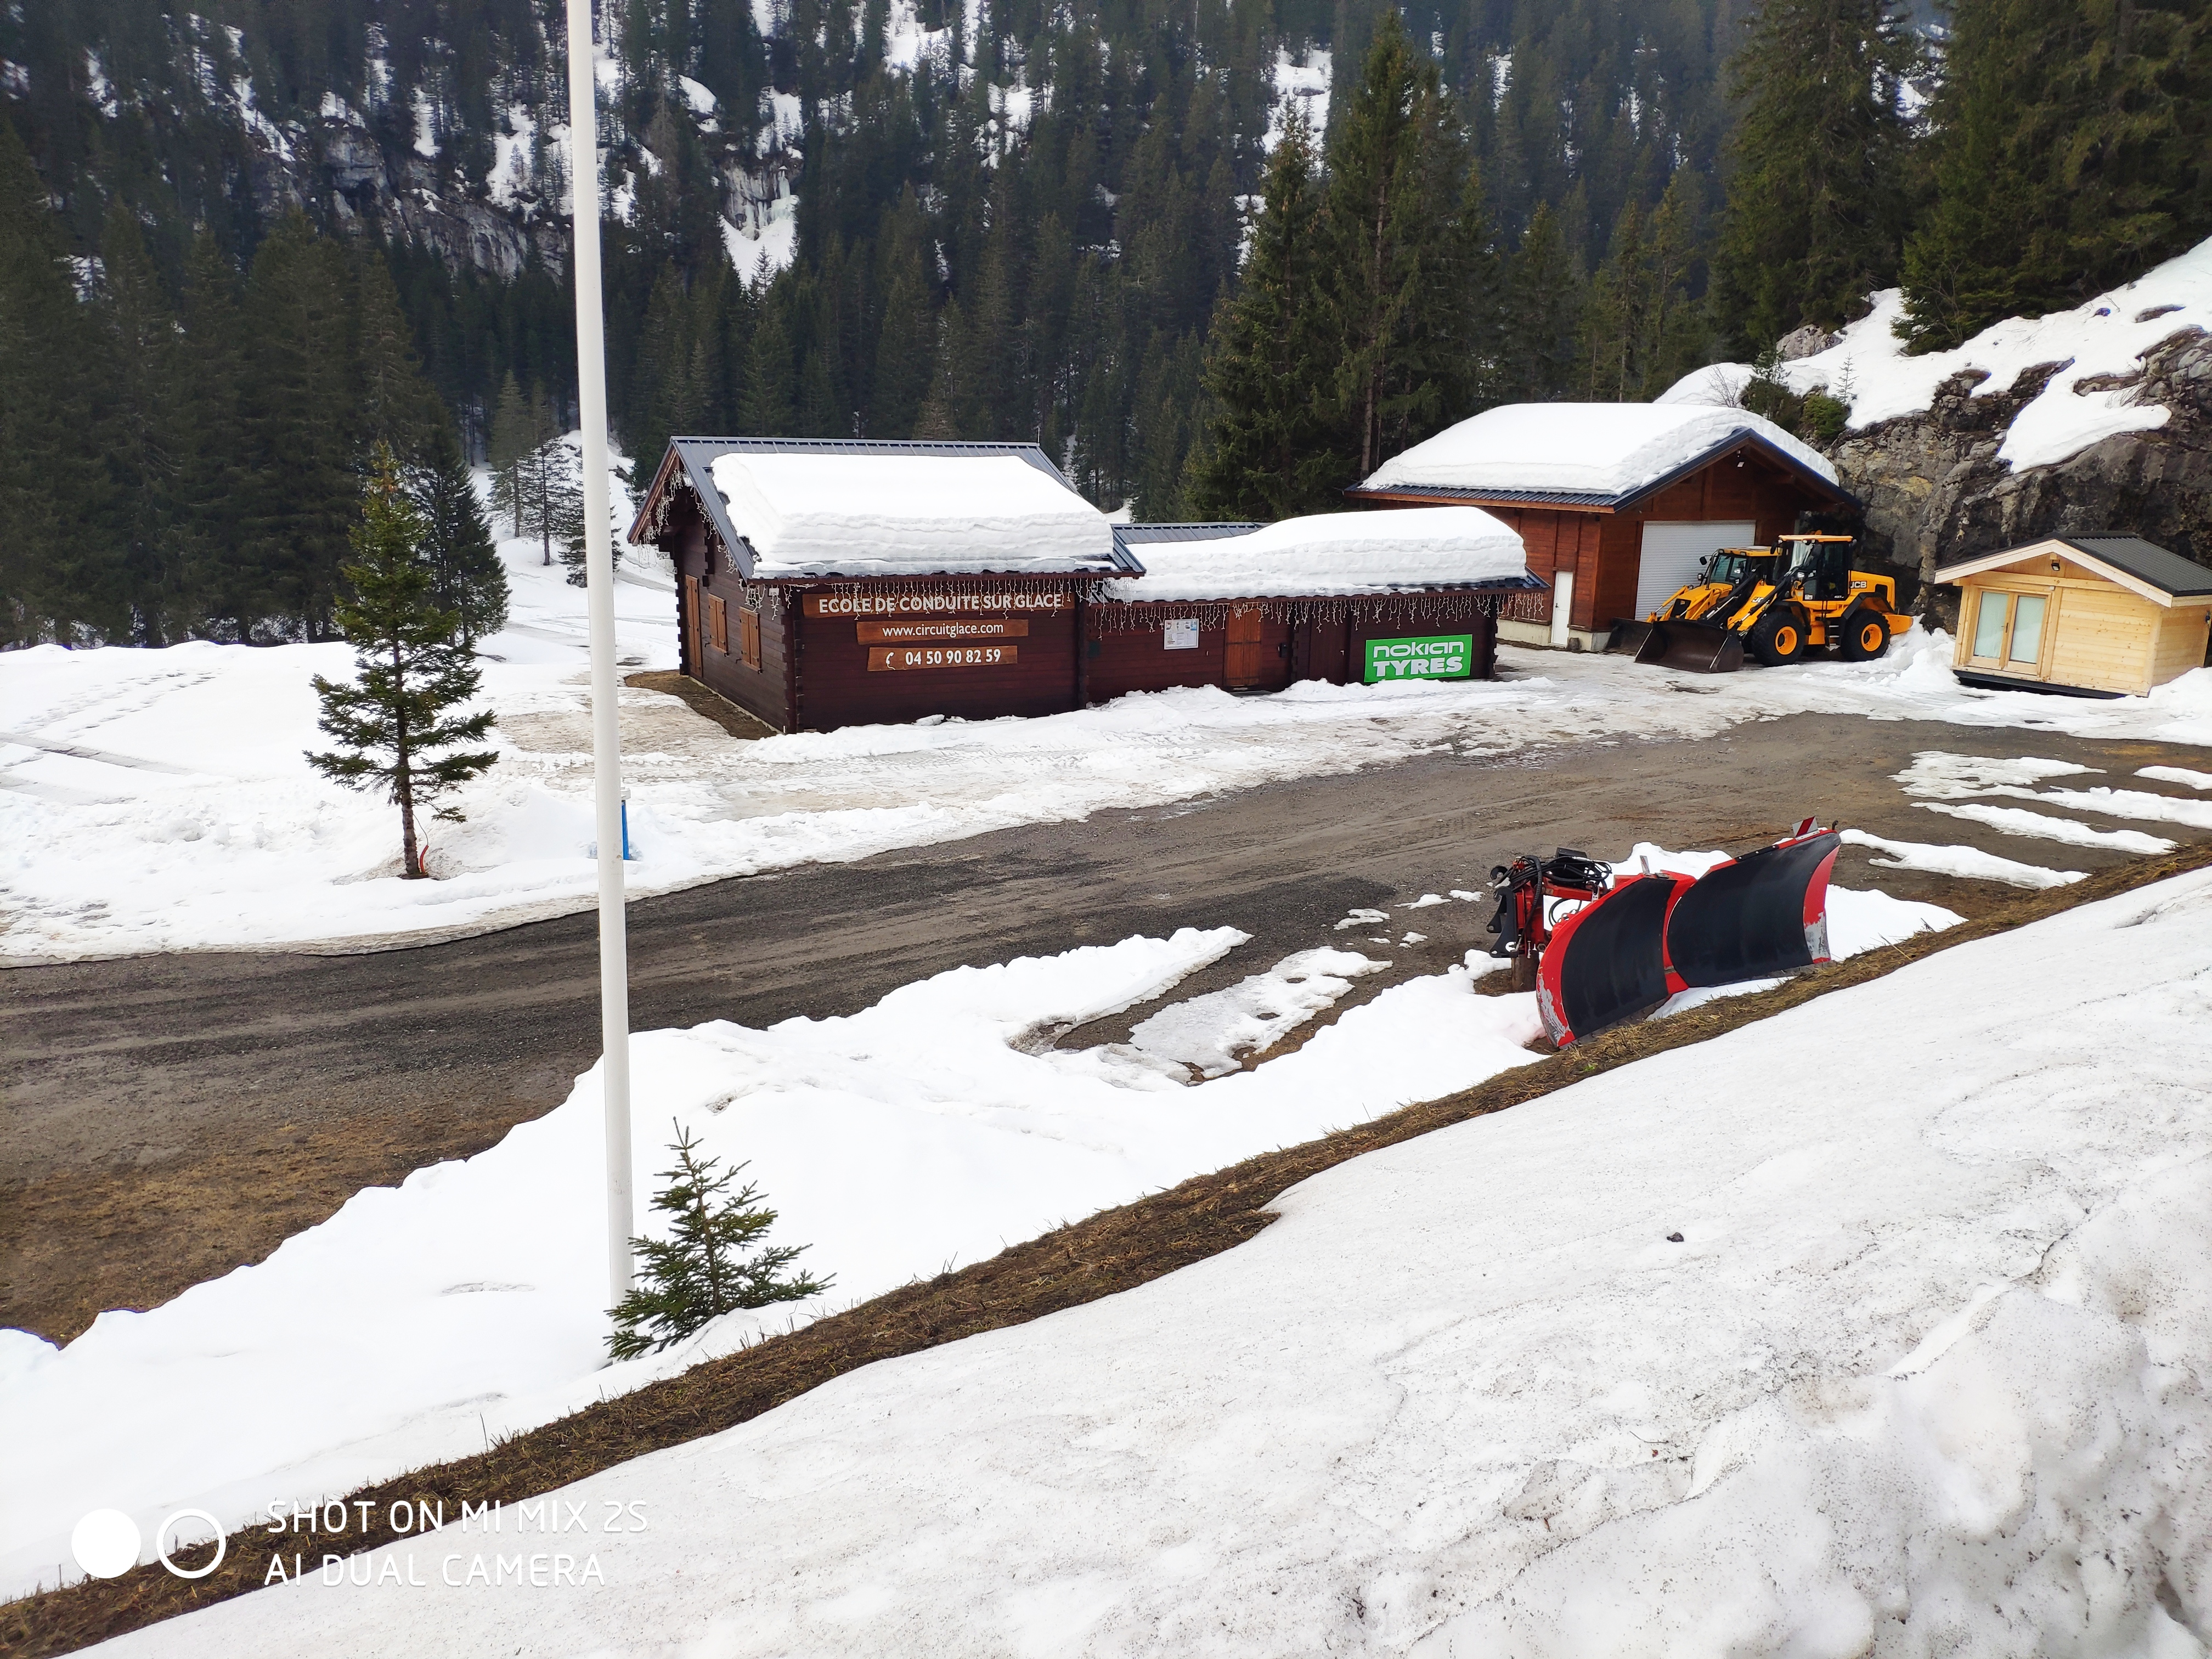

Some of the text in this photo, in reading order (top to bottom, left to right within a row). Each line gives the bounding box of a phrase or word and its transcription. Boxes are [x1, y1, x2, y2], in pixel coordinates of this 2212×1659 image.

[819, 594, 1062, 613] ECOLE DE CONDUITE SUR GLACE
[882, 622, 1003, 638] www.circuitglace.com
[905, 648, 1001, 665] 04 50 90 82 59
[1373, 656, 1463, 677] TYRES
